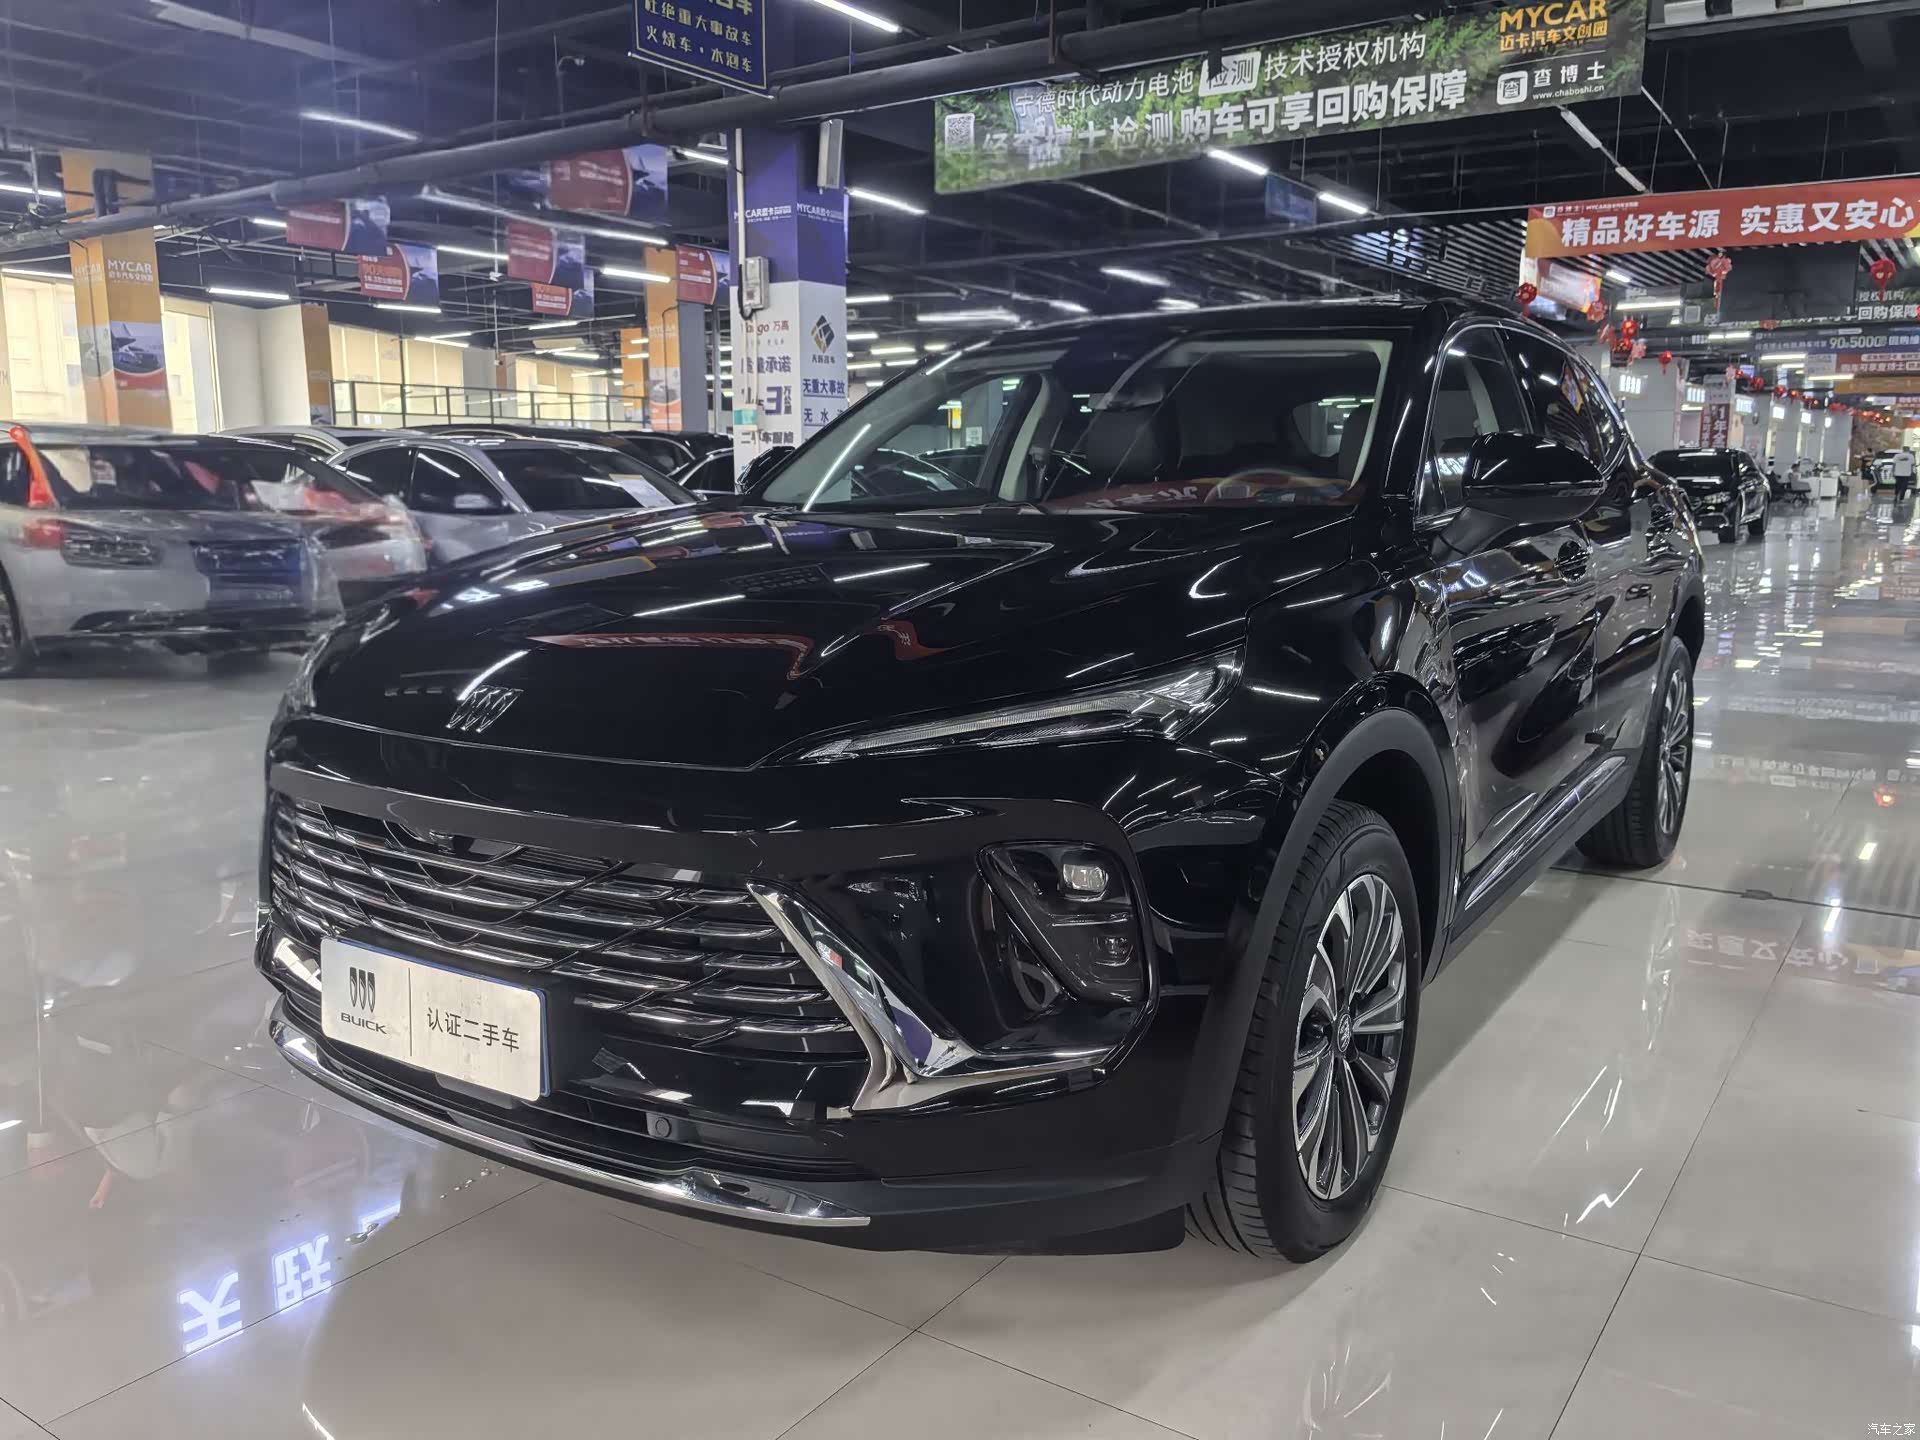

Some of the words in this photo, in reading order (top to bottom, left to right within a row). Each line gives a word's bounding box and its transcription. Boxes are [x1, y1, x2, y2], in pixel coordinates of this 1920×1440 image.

[1500, 0, 1608, 32] MYCAR
[1500, 20, 1608, 51] 迈卡汽车文创园
[1014, 69, 1194, 117] 宁德时代动力电池
[1264, 31, 1427, 82] 技术授权机构
[1533, 61, 1606, 88] 查博士
[1533, 84, 1605, 100] www.chaboshi.cn
[1561, 208, 1721, 247] 精品好车源
[1740, 197, 1914, 236] 实惠又安心
[107, 259, 153, 274] MYCAR
[803, 378, 846, 396] 无重大事故
[341, 1012, 388, 1035] BUICK
[427, 1007, 520, 1053] 认证二手车
